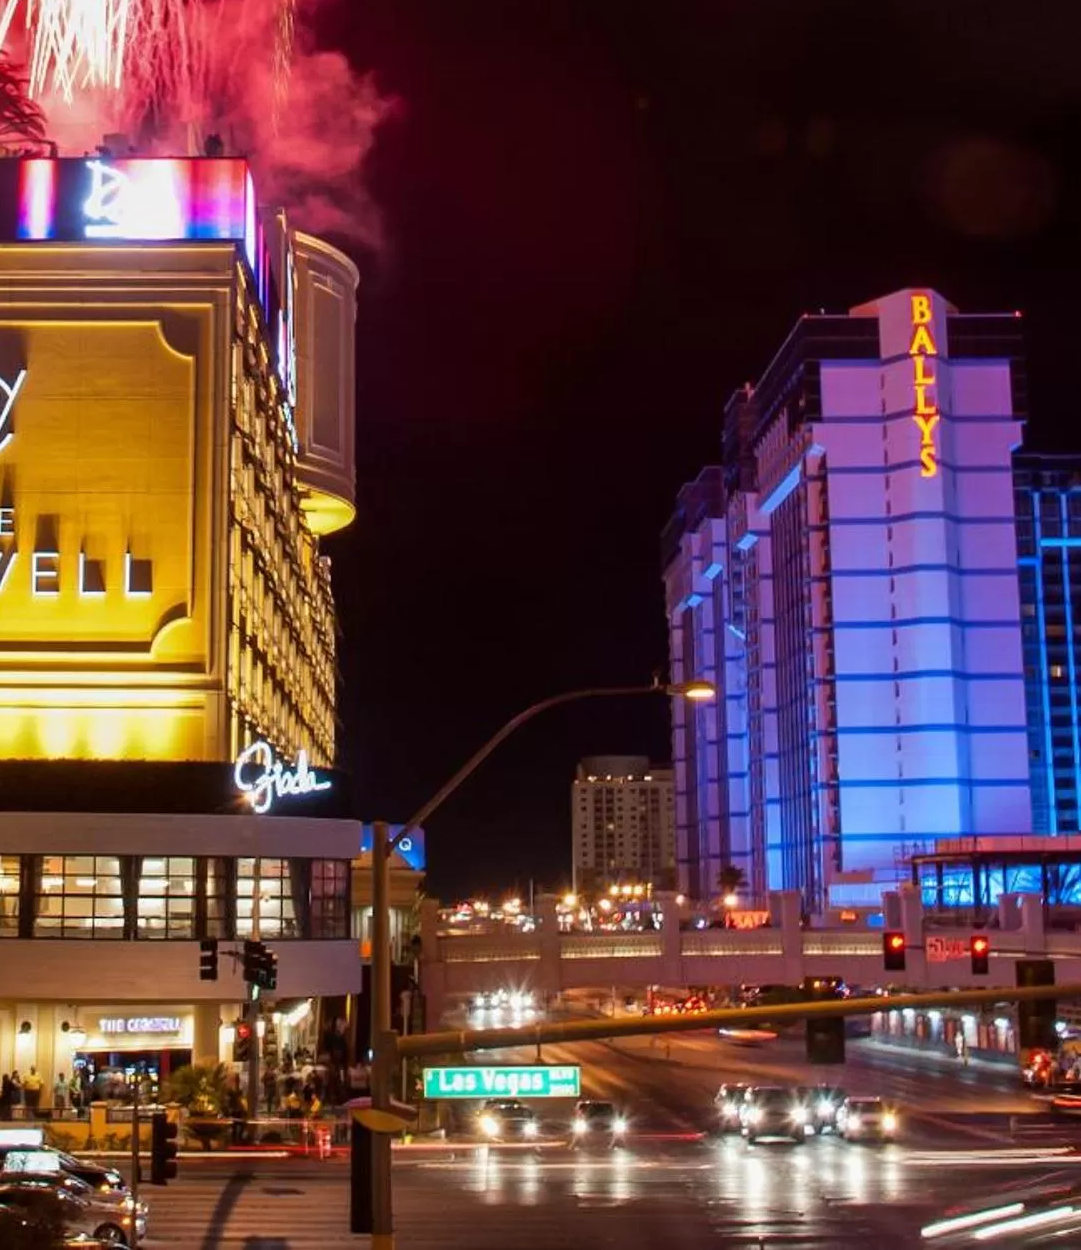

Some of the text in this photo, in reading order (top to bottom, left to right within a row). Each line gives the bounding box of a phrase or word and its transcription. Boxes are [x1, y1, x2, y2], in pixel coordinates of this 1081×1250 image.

[234, 740, 332, 814] Giada
[439, 1069, 476, 1091] Las
[480, 1068, 544, 1098] Vegas
